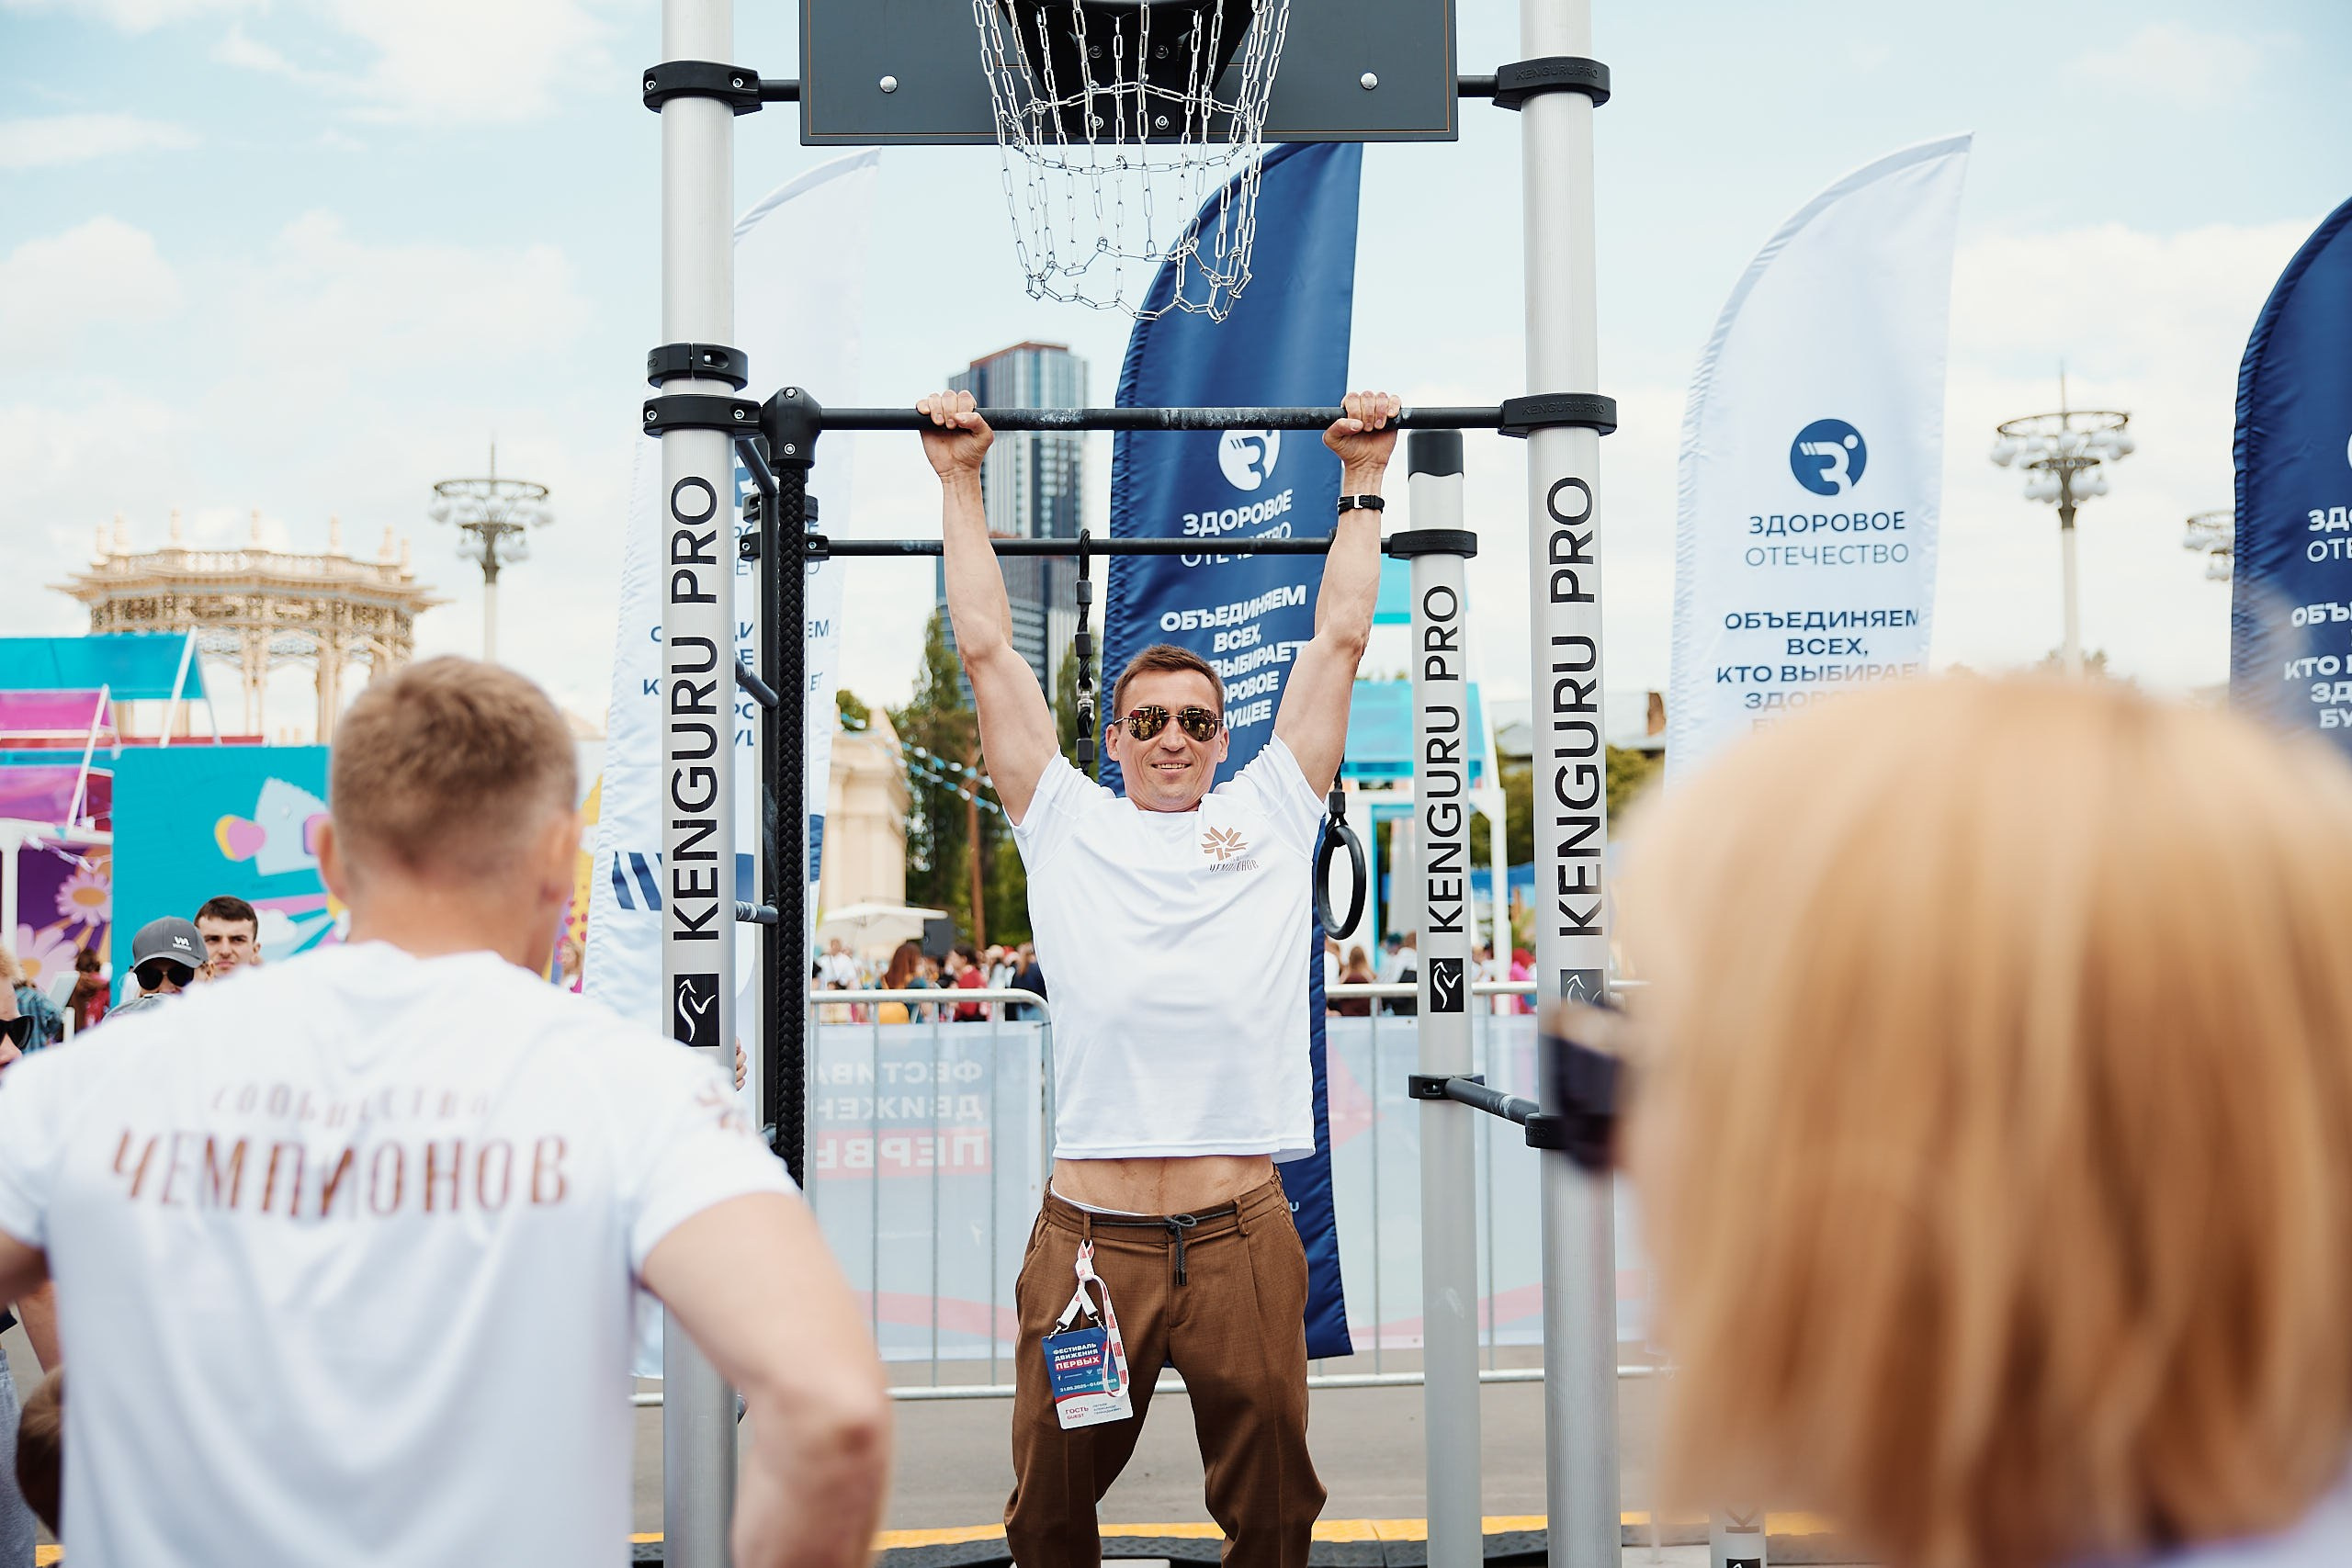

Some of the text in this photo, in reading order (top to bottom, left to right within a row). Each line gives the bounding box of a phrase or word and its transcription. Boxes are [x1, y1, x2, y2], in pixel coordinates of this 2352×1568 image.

[1182, 489, 1293, 537] ЗДОРОВОЕ
[1748, 511, 1906, 536] ЗДОРОВОЕ
[2307, 506, 2352, 533] ЗД
[1746, 544, 1909, 566] ОТЕЧЕСТВО
[1159, 584, 1307, 633] ОБЪЕДИНЯЕМ
[2291, 601, 2352, 627] ОБЪ
[1787, 638, 1868, 656] ВСЕХ,
[1717, 662, 1919, 683] КТО ВЫБИРАЕ
[2284, 655, 2341, 681] КТО
[671, 476, 719, 942] KENGURU PRO
[1547, 477, 1603, 936] KENGURU PRO
[1423, 585, 1464, 934] KENGURU PRO
[111, 1129, 570, 1218] ЧЕМПИОНОВ
[1053, 1343, 1097, 1355] ФЕСТИВАЛЬ
[1055, 1349, 1099, 1361] ДВИЖЕНИЯ
[1056, 1357, 1100, 1370] ПЕРВЫХ
[1065, 1406, 1089, 1415] ГОСТЬ
